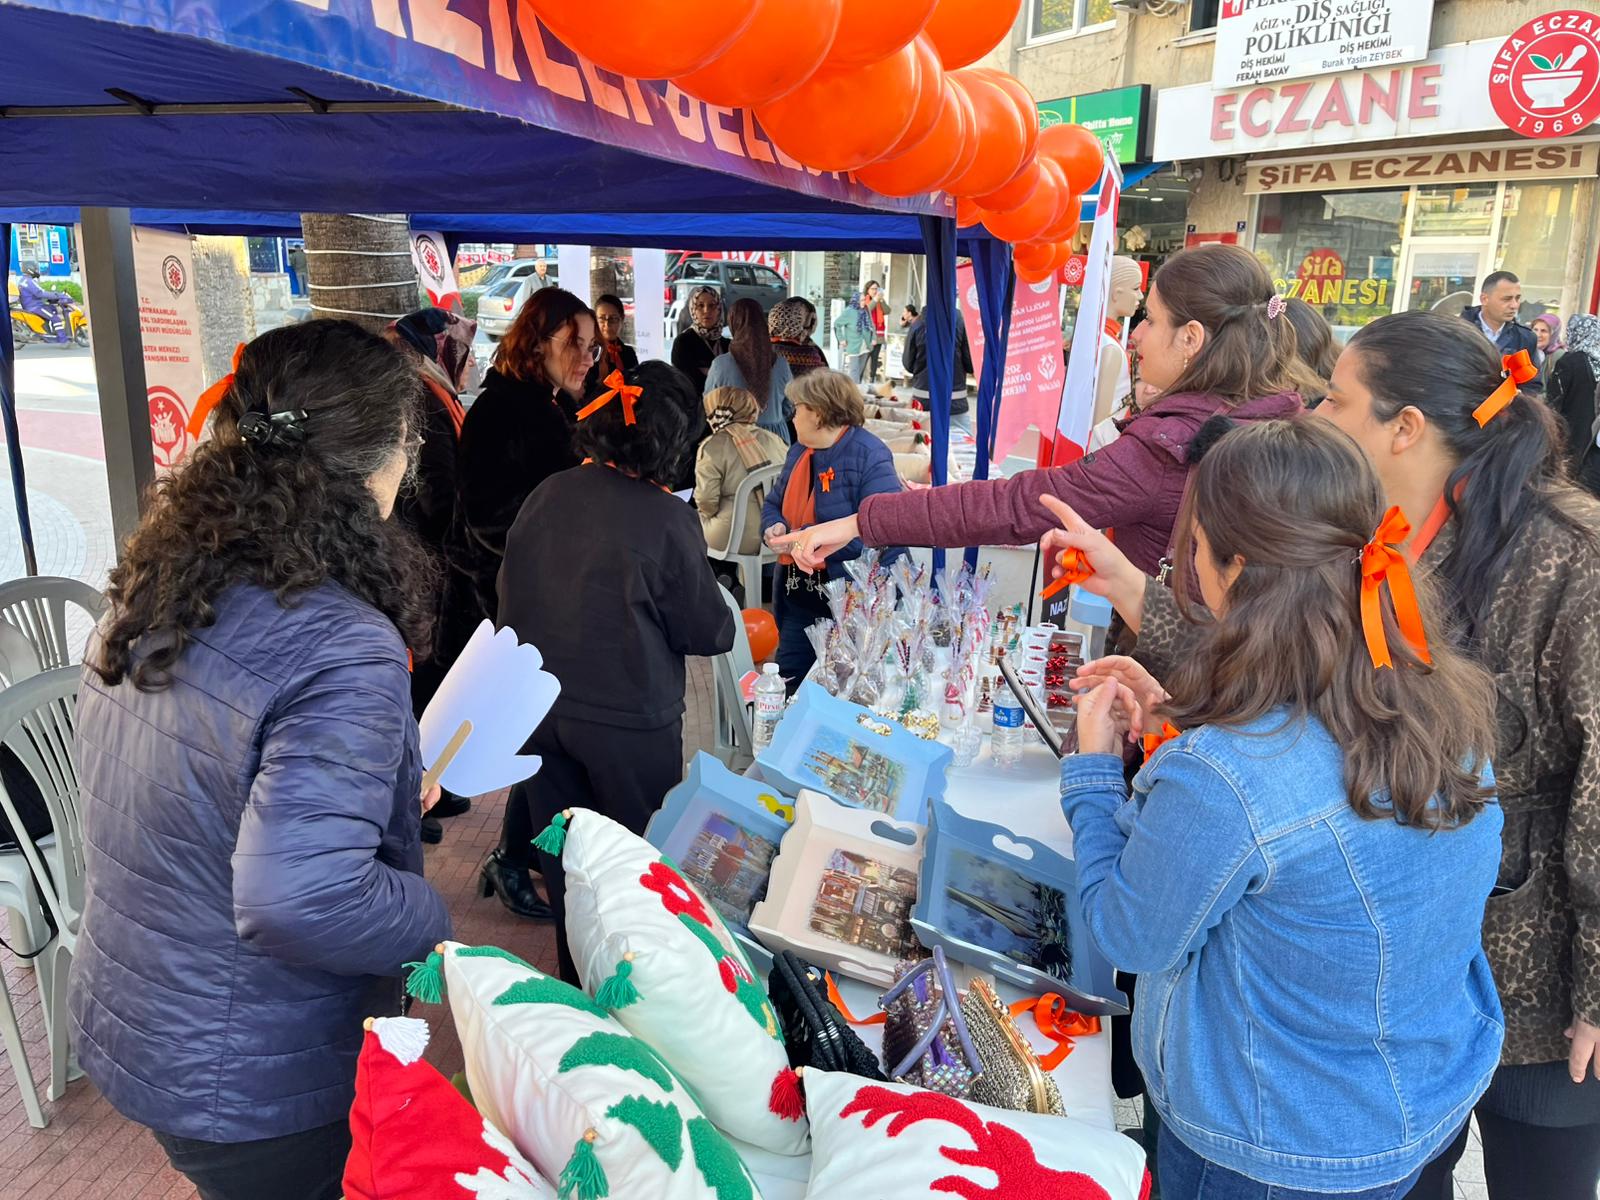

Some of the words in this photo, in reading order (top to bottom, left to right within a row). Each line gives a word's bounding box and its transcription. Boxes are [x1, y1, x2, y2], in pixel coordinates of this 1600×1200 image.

[1253, 18, 1279, 32] AĞIZ
[1281, 17, 1292, 26] ve
[1295, 0, 1332, 24] DİŞ
[1245, 7, 1393, 56] POLİKLİNİĞİ
[1340, 43, 1357, 54] DİŞ
[1357, 36, 1392, 52] HEKİMİ
[1240, 57, 1255, 69] DİŞ
[1255, 52, 1286, 68] HEKİMİ
[1321, 56, 1345, 69] Burak
[1346, 54, 1368, 66] Yasin
[1369, 49, 1403, 62] ZEYBEK
[1492, 38, 1526, 84] ŞİFA
[1236, 69, 1262, 82] FERAH
[1210, 64, 1444, 141] ECZANE
[1517, 112, 1583, 133] 1968
[1258, 162, 1337, 191] ŞİFA
[1349, 145, 1584, 181] ECZANESİ
[1301, 255, 1343, 281] Şifa
